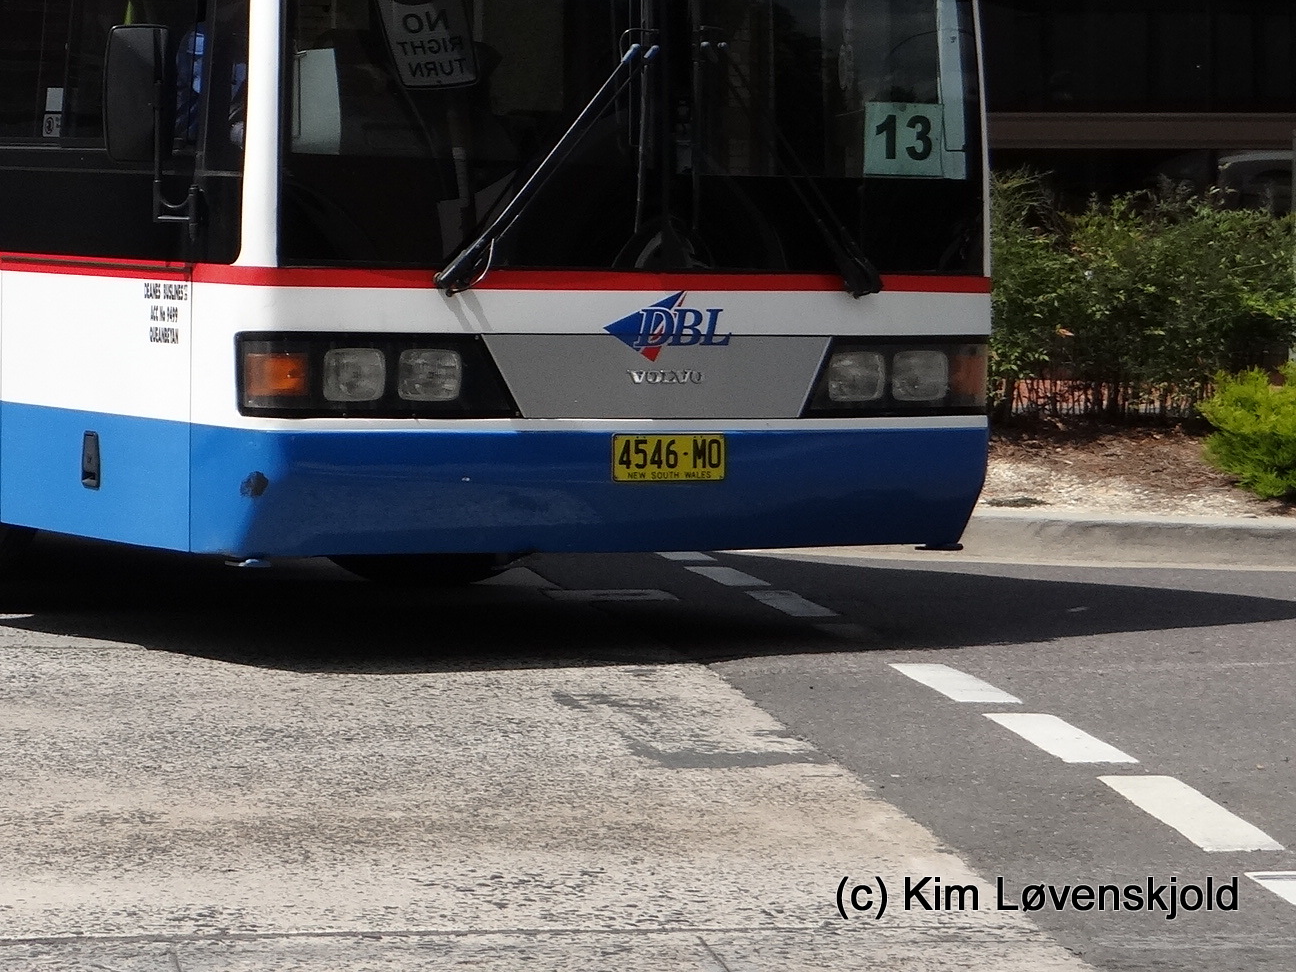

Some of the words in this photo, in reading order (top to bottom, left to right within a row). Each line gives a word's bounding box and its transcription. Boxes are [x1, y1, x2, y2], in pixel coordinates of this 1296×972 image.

[875, 114, 933, 161] 13
[633, 307, 732, 348] DBL
[627, 369, 703, 384] VOLVO
[627, 471, 646, 479] NEW
[651, 471, 680, 479] SOUTH
[684, 471, 711, 479] WALES
